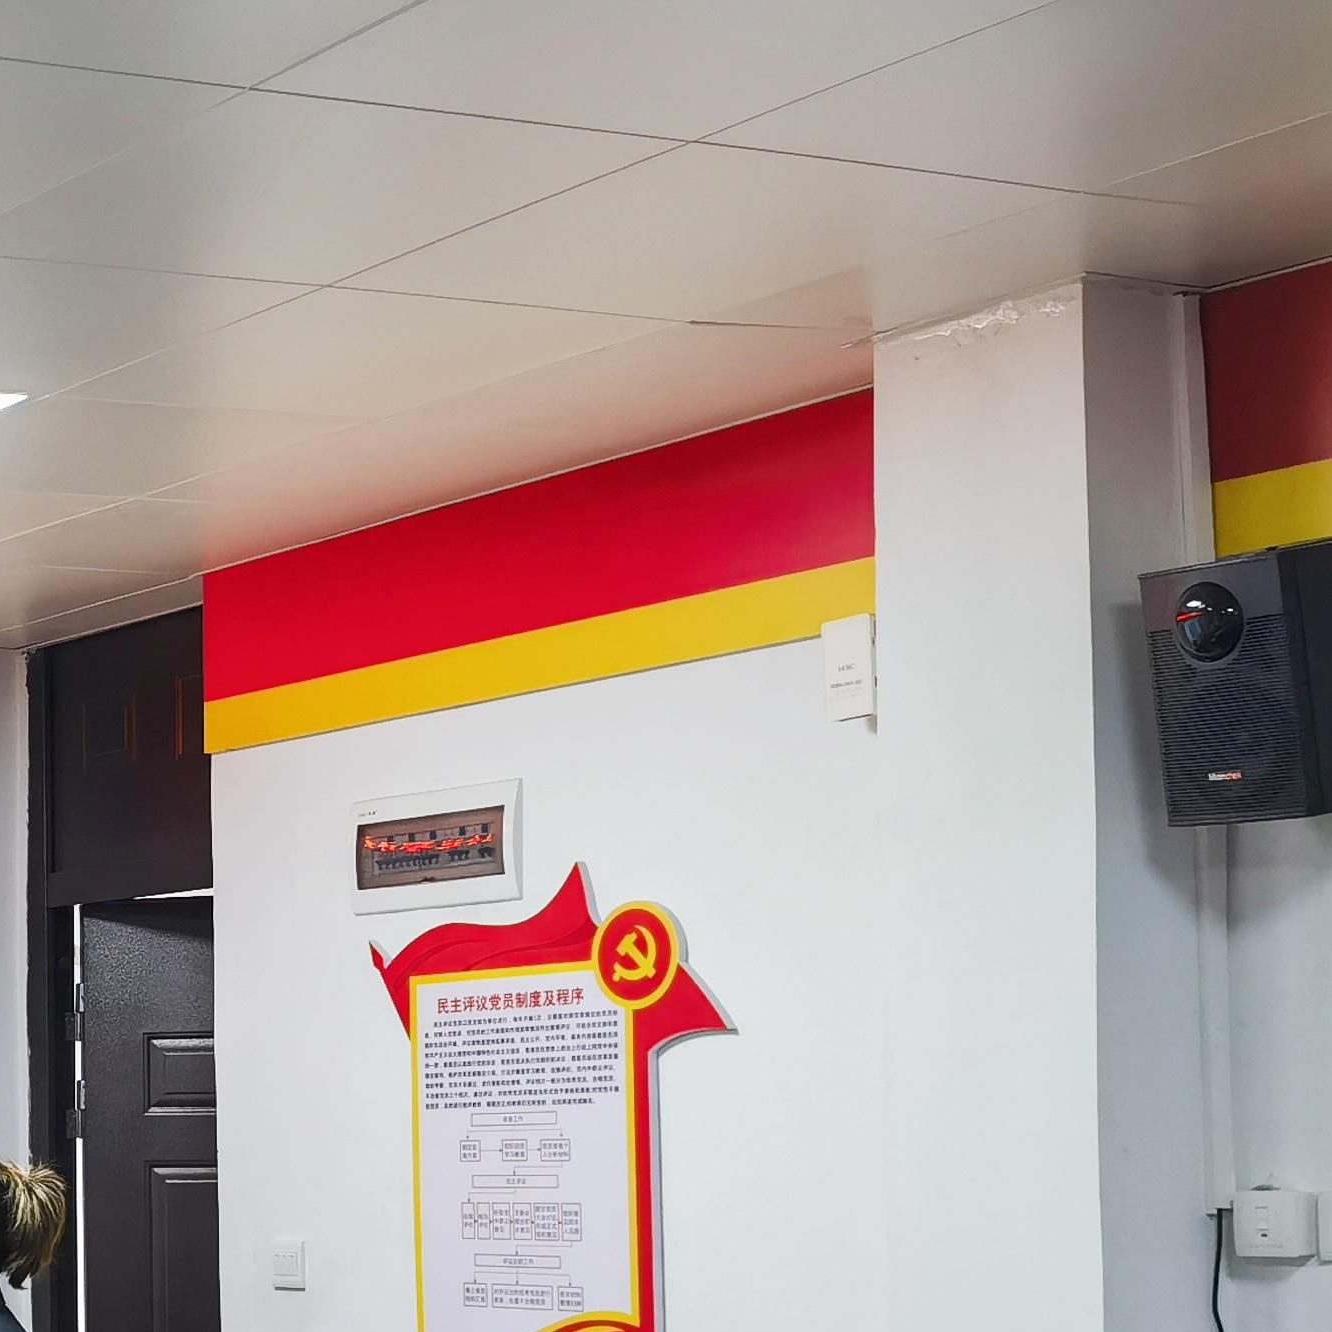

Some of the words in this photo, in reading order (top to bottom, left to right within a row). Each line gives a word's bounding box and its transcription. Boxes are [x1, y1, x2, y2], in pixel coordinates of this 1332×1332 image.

[437, 987, 585, 1015] 民主评议党员制度及程序
